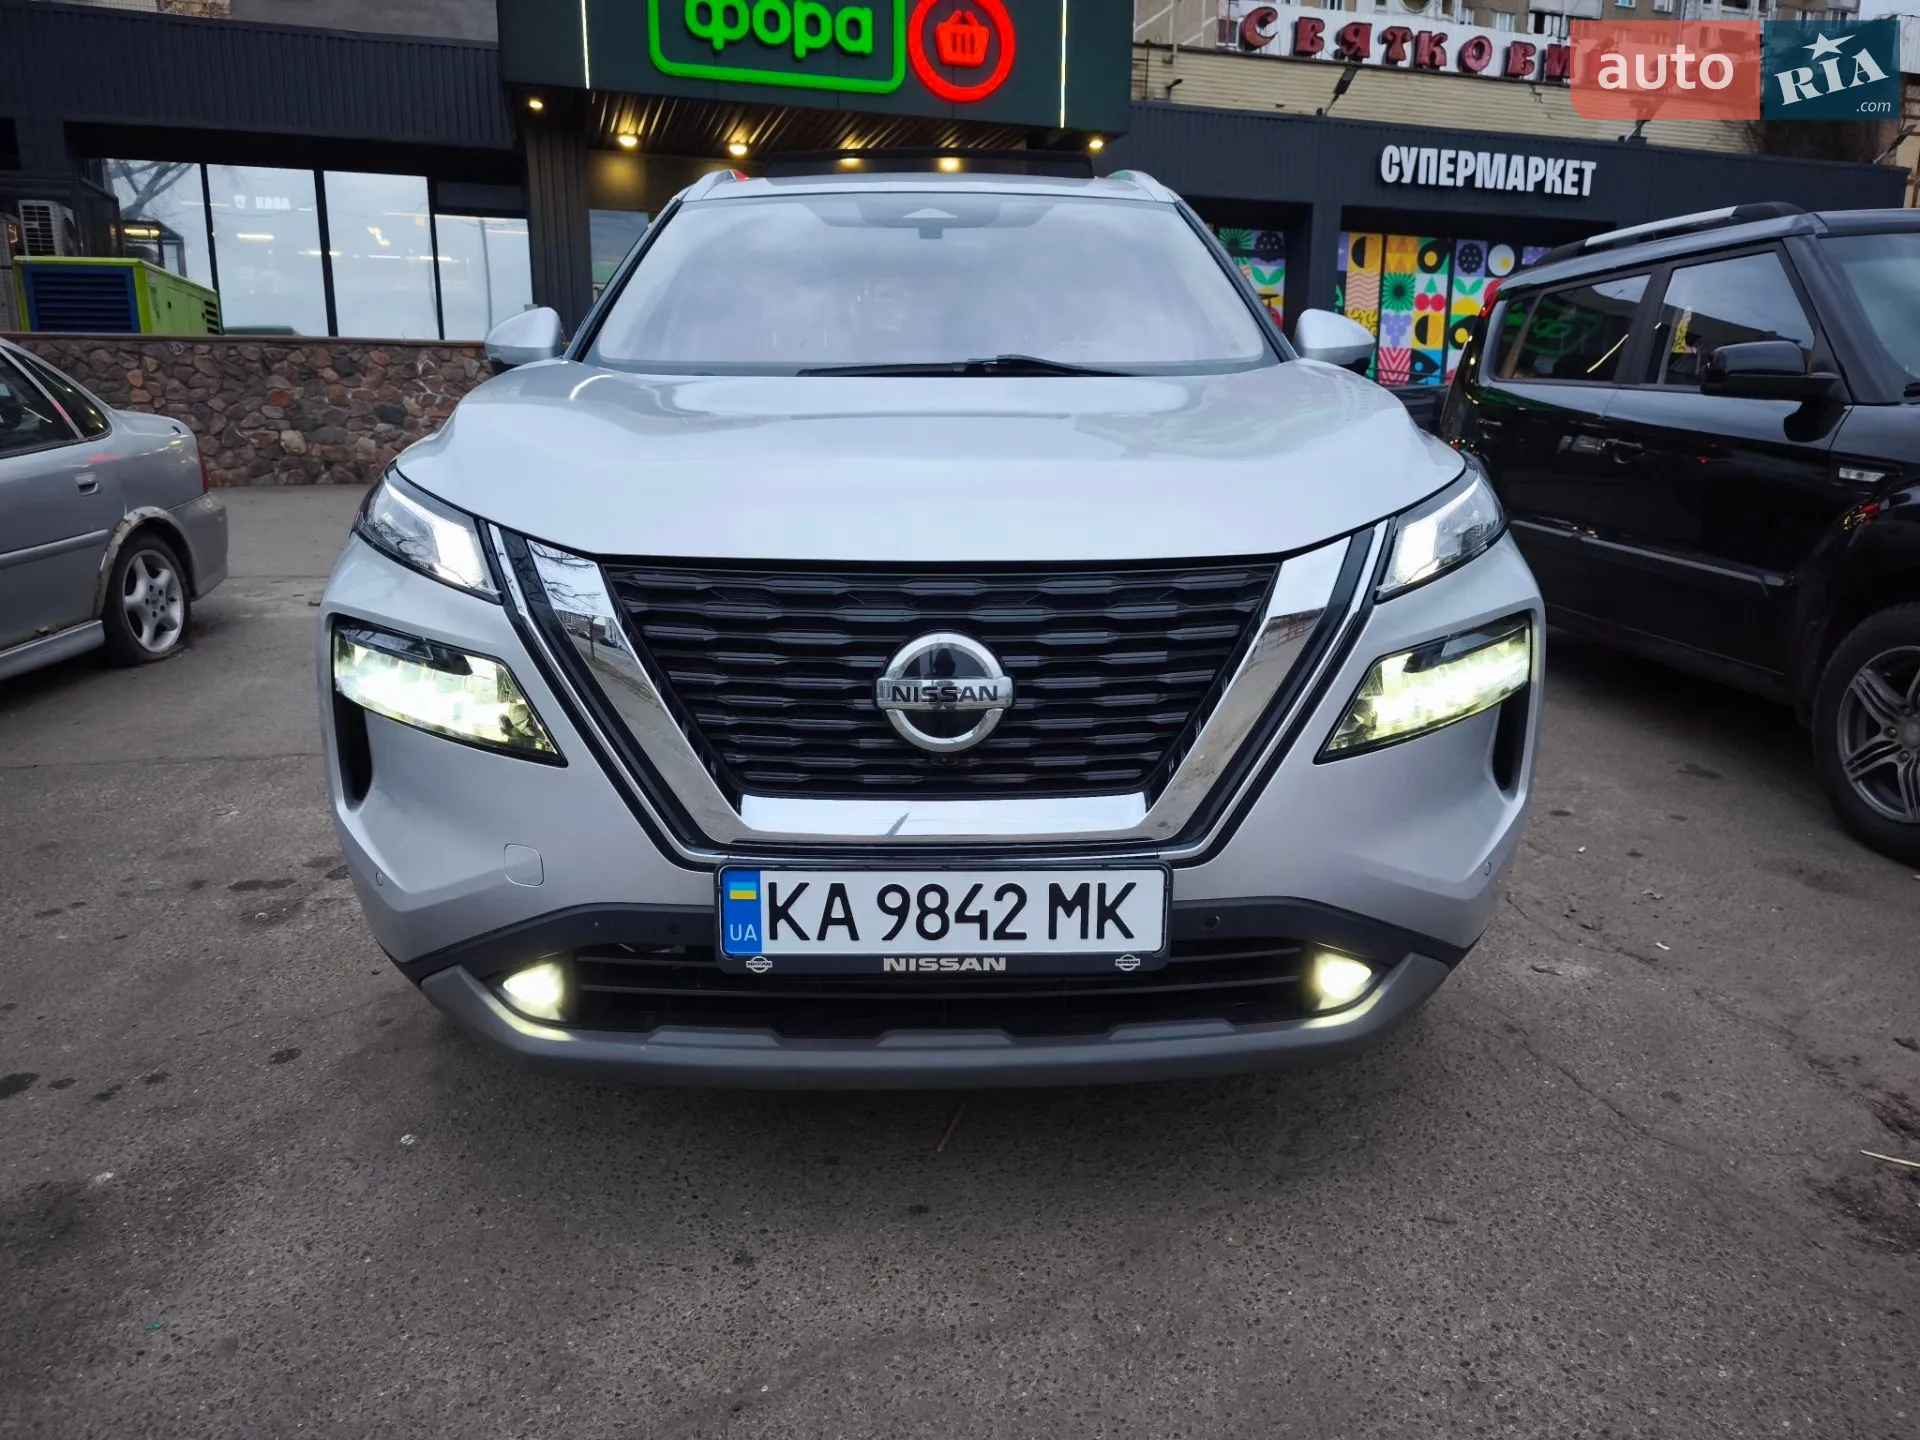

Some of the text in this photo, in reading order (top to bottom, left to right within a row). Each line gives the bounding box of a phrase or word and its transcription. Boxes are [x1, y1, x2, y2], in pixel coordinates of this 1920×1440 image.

[685, 0, 873, 58] фора
[1381, 145, 1597, 196] СУПЕРМАРКЕТ
[891, 685, 998, 702] NISSAN
[768, 882, 1137, 941] KA 9842 MK
[730, 924, 757, 941] UA
[883, 957, 1007, 972] NISSAN
